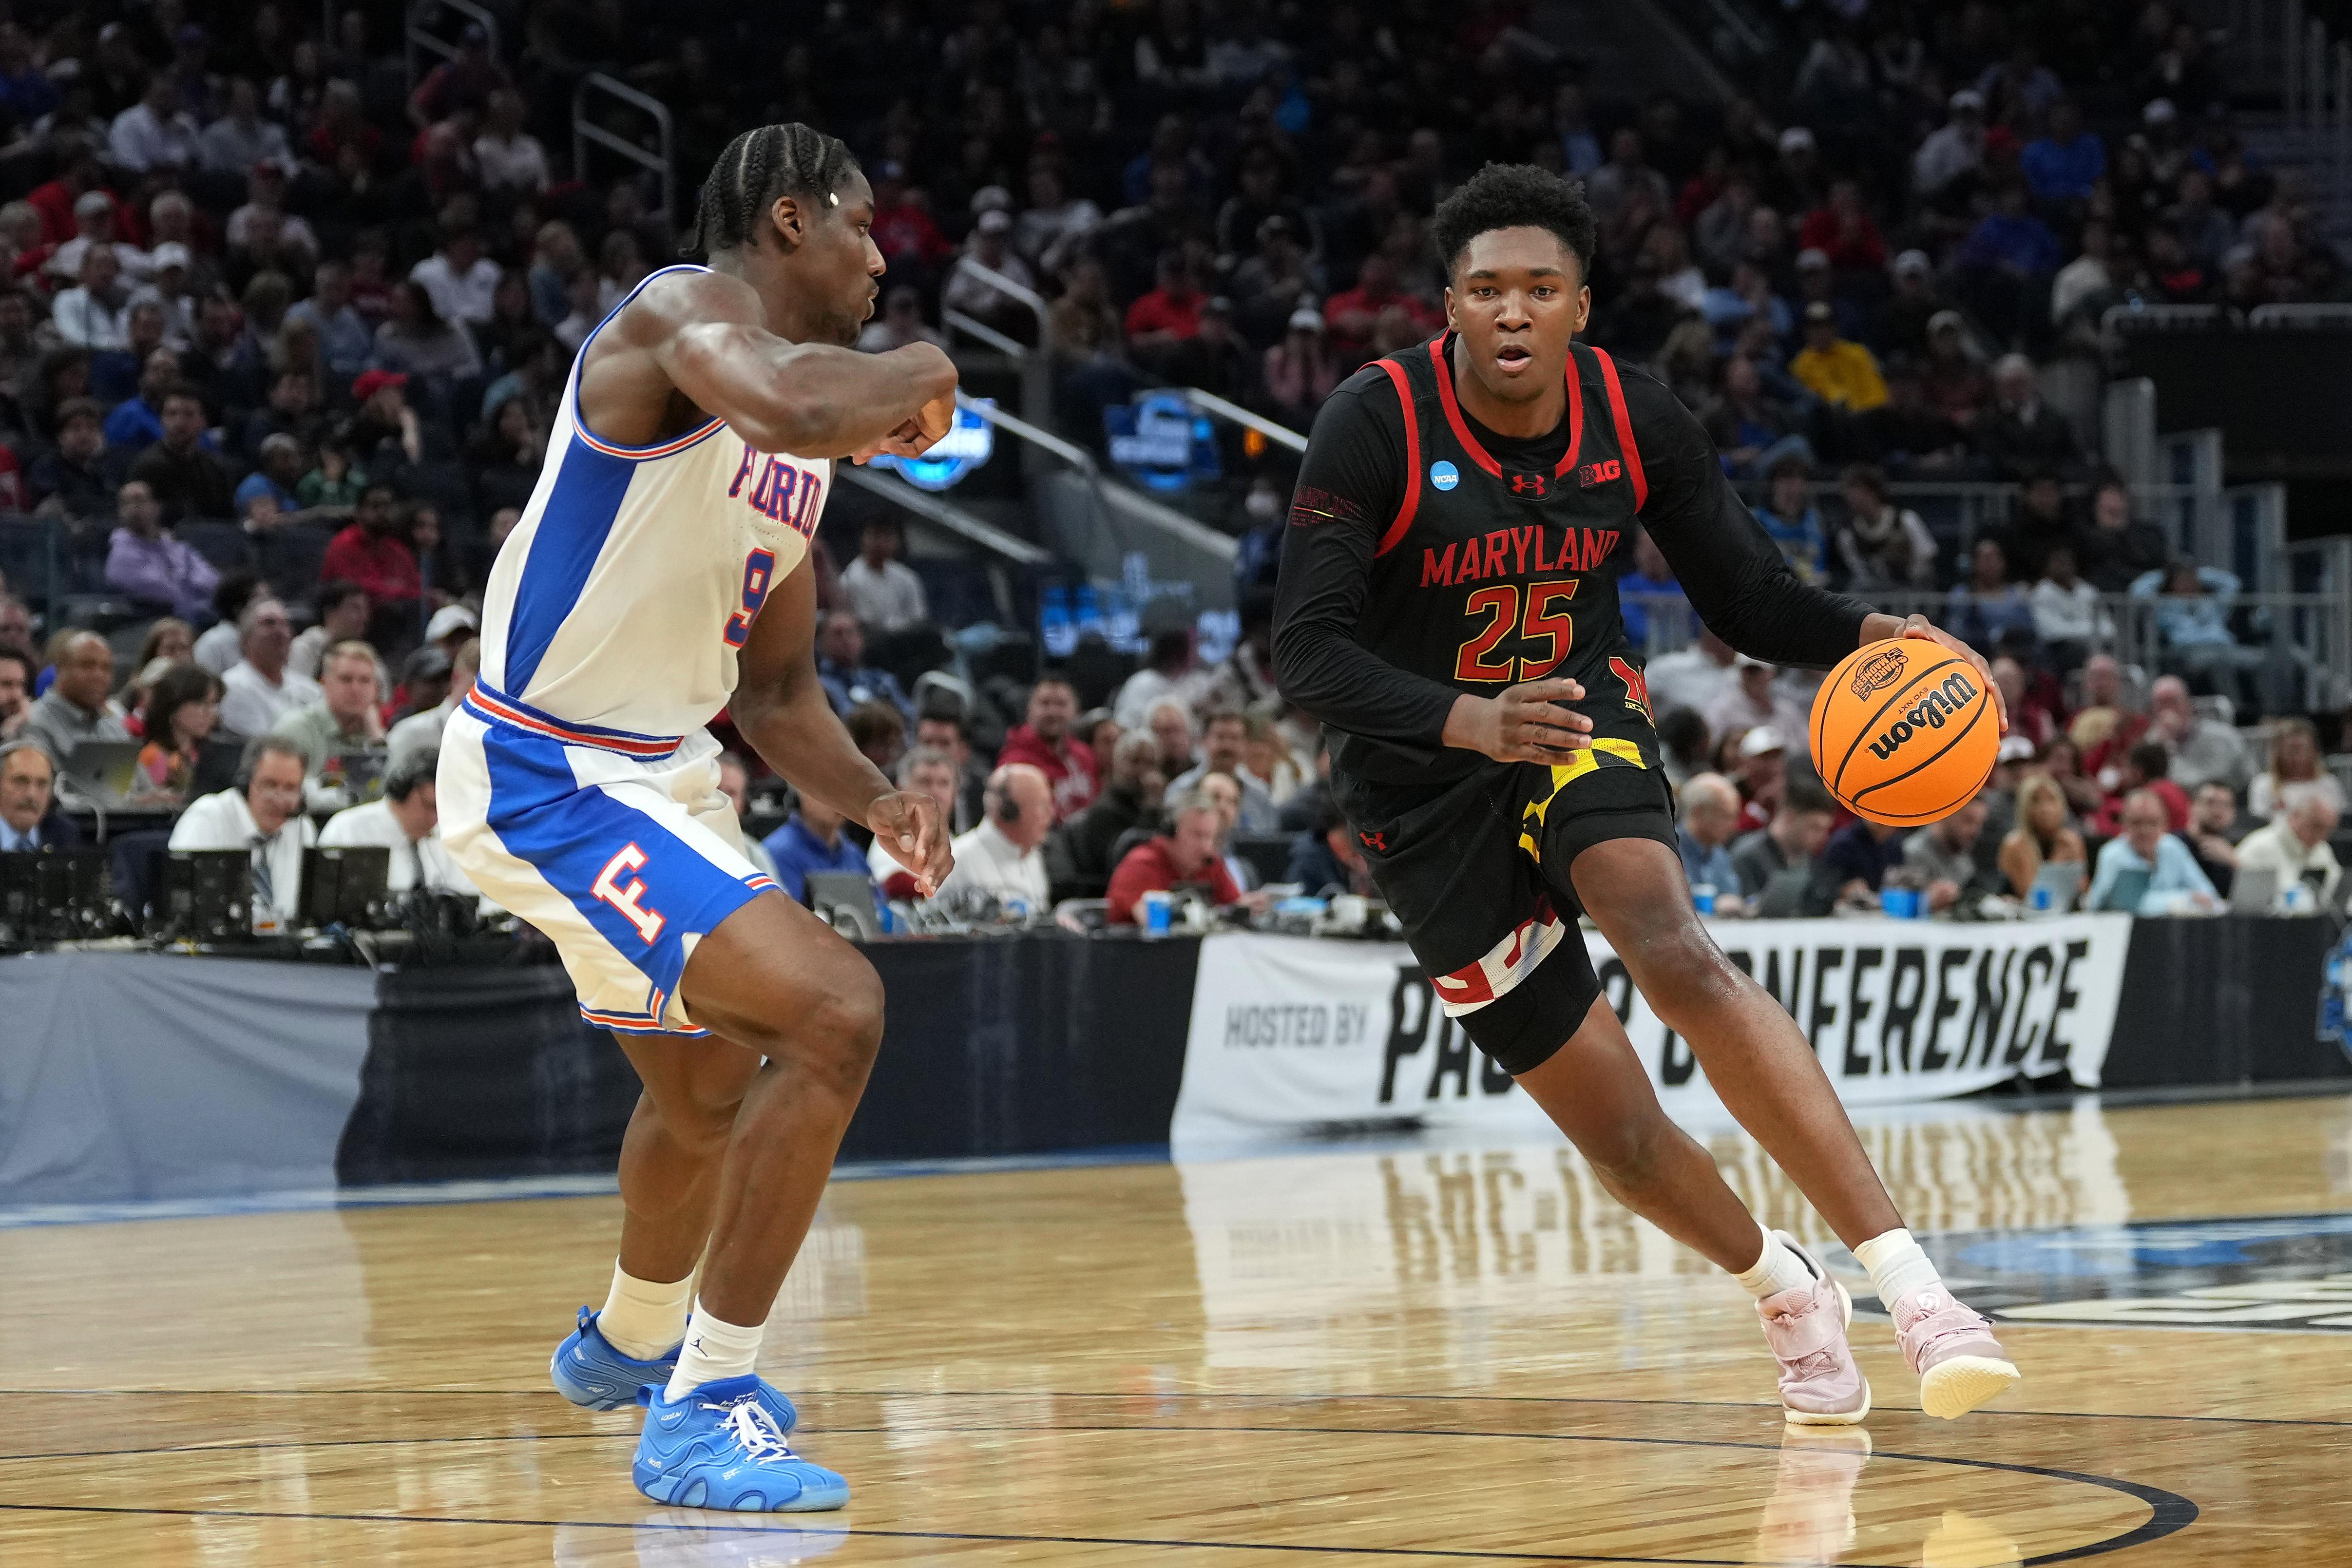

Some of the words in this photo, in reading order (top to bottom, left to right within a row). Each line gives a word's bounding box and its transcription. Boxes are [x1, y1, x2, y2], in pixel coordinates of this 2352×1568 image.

[1434, 475, 1458, 483] NCAA
[1420, 525, 1620, 587] MARYLAND
[723, 547, 775, 649] 9
[1454, 579, 1579, 682] 25
[1851, 657, 1889, 694] MADNESS
[1869, 659, 1899, 686] MARCH
[1913, 687, 1928, 700] EVO
[1868, 672, 1978, 760] Wilson
[1898, 699, 1913, 715] NXT
[590, 841, 667, 946] F
[1224, 1004, 1327, 1048] HOSTED
[1335, 1004, 1368, 1047] BY
